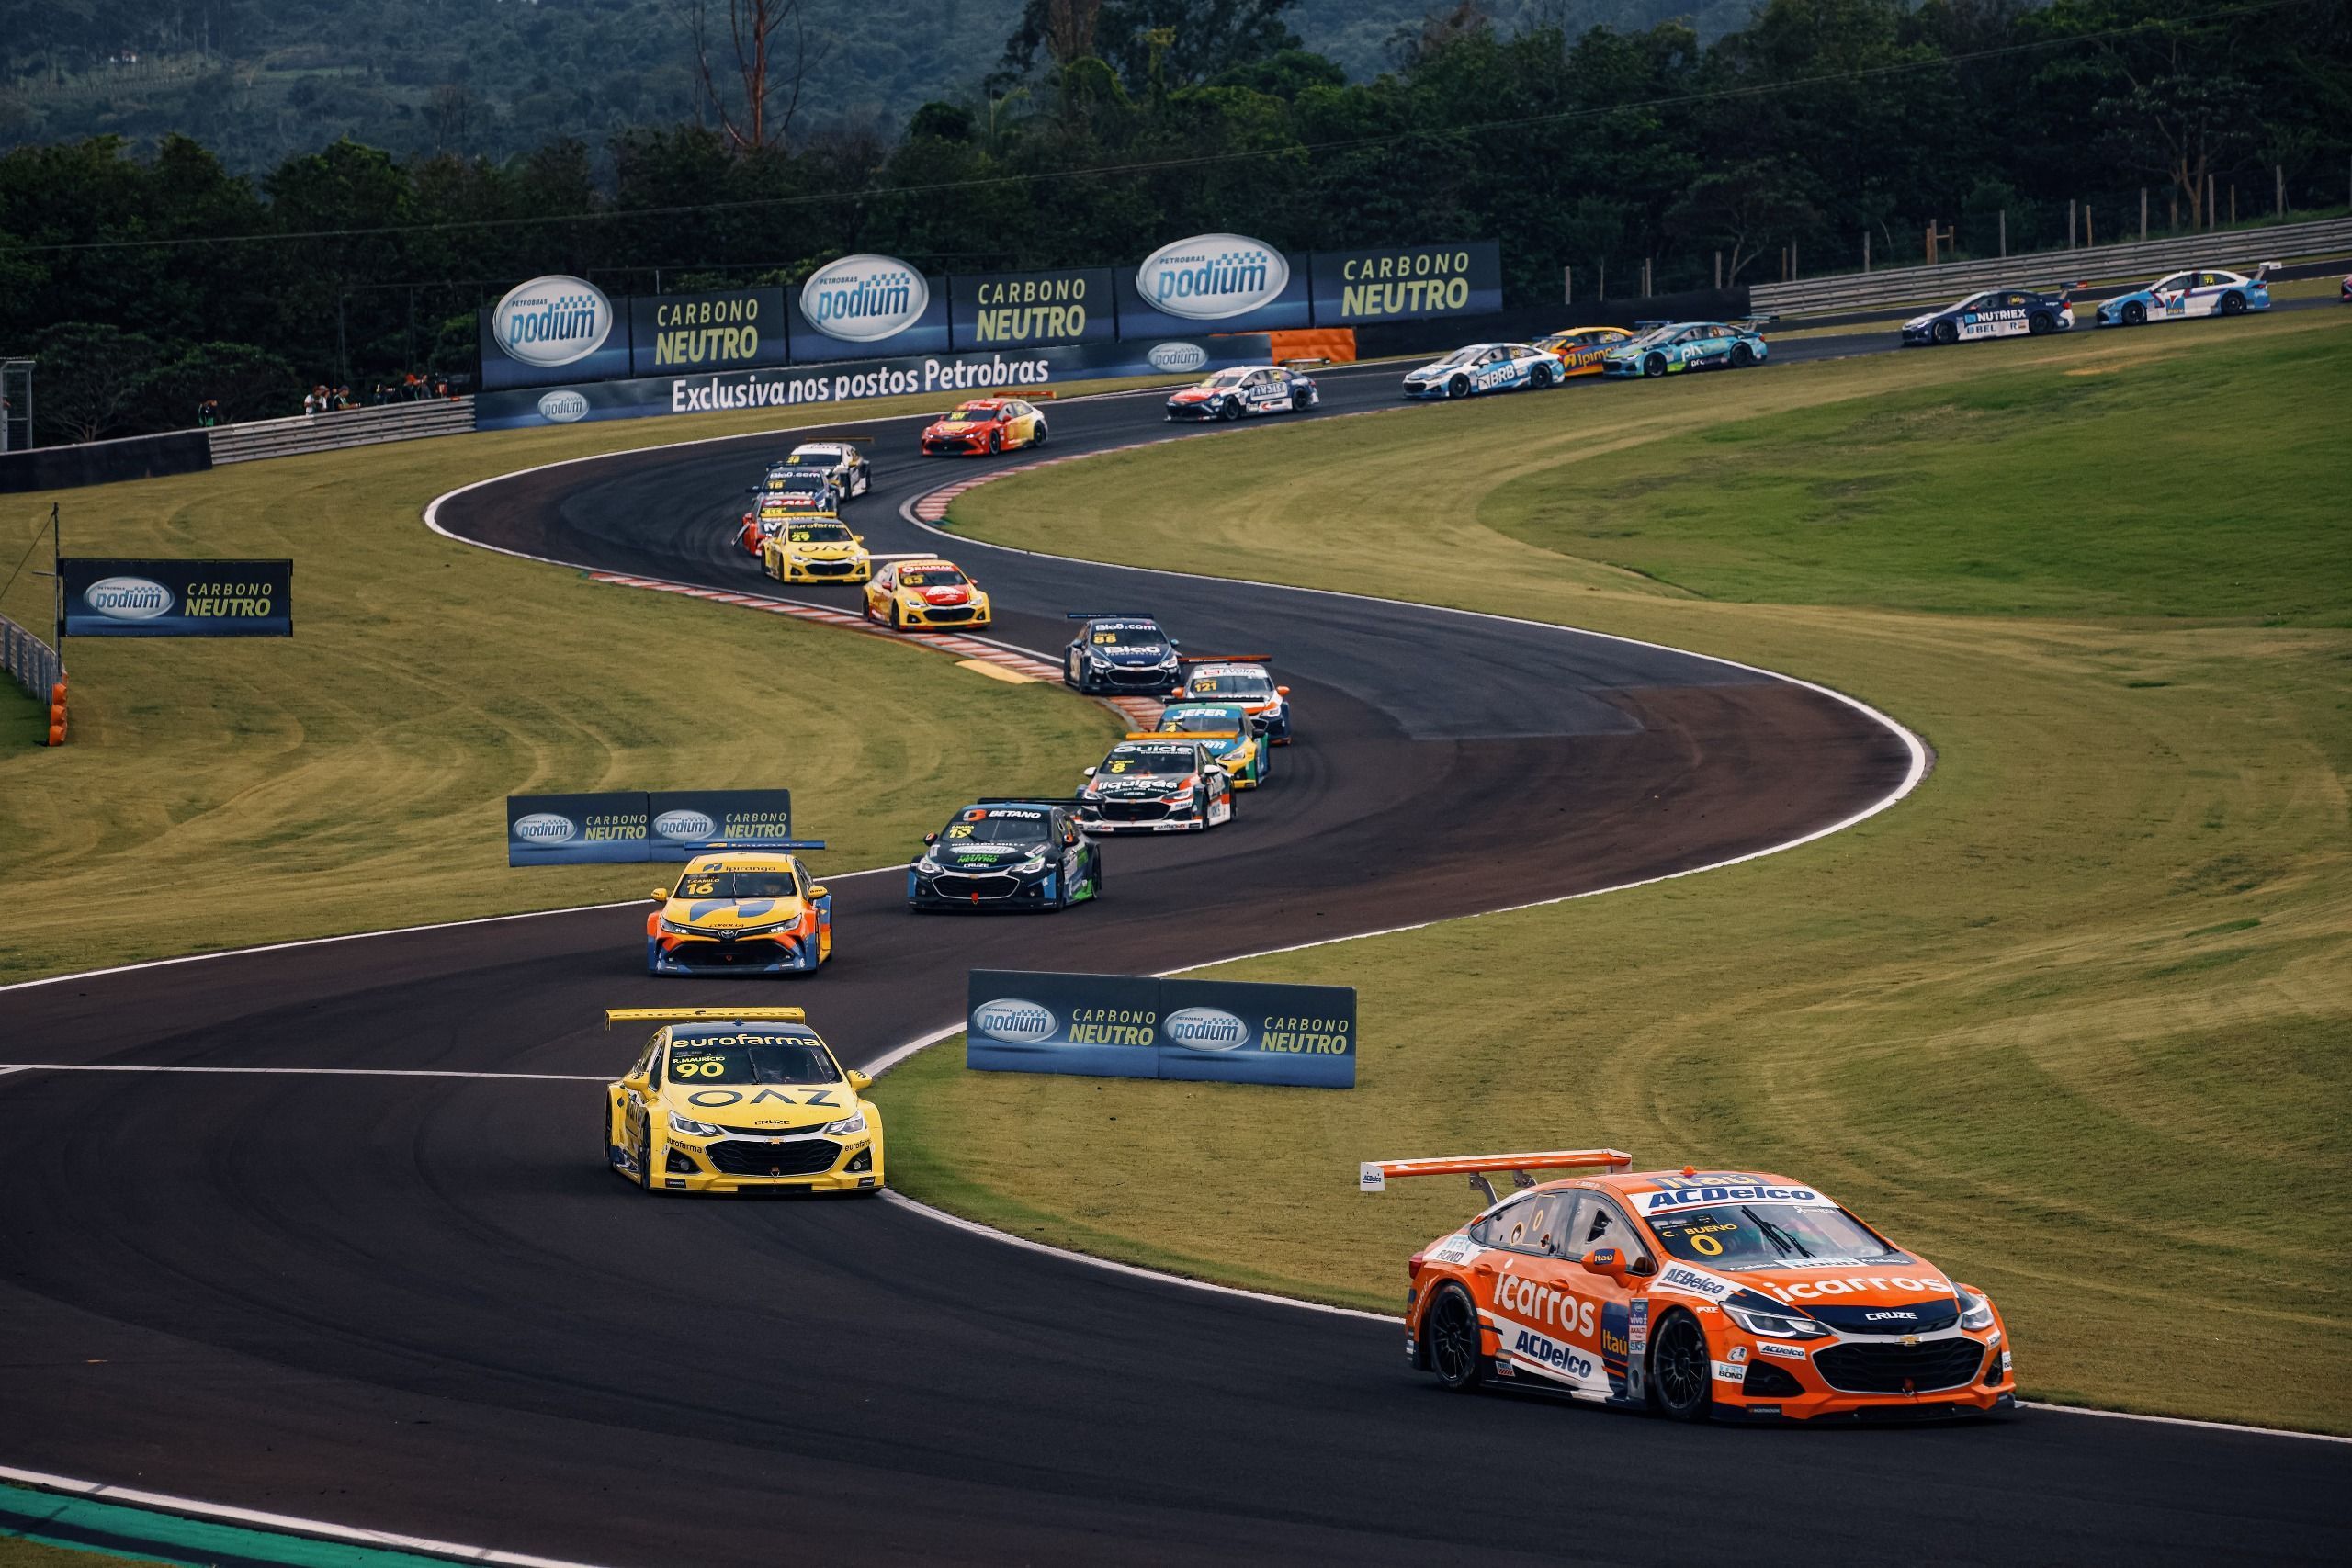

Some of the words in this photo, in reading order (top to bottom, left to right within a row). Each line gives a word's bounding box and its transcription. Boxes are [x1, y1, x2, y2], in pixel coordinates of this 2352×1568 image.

[1159, 254, 1206, 265] PETROBRAS
[1343, 251, 1470, 281] CARBONO
[820, 276, 858, 285] PETROBRAS
[1156, 258, 1269, 303] podium
[978, 278, 1086, 305] CARBONO
[1341, 276, 1470, 318] NEUTRO
[511, 298, 548, 307] PETROBRAS
[815, 279, 910, 325] podium
[657, 298, 759, 327] CARBONO
[1976, 309, 2027, 322] NUTRIEX
[509, 303, 596, 348] podium
[976, 304, 1086, 342] NEUTRO
[655, 324, 759, 366] NEUTRO
[1154, 351, 1200, 366] podium
[672, 375, 786, 413] Exclusiva
[788, 378, 829, 404] nos
[835, 367, 919, 401] postos
[924, 354, 1049, 391] Petrobras
[1489, 365, 1516, 387] BRB
[544, 397, 582, 415] podium
[791, 533, 811, 542] 29
[187, 582, 273, 596] CARBONO
[95, 588, 162, 611] podium
[184, 597, 272, 617] NEUTRO
[1093, 635, 1117, 645] 88
[1194, 681, 1217, 693] 121
[1172, 708, 1227, 720] JEFER
[1110, 762, 1126, 773] 8
[585, 814, 648, 826] CARBONO
[725, 812, 787, 823] CARBONO
[989, 810, 1042, 818] BETANO
[520, 819, 568, 840] podium
[584, 823, 647, 840] NEUTRO
[660, 818, 707, 835] podium
[723, 822, 787, 840] NEUTRO
[957, 855, 998, 863] NEUTRO
[725, 864, 776, 873] ipiranga
[686, 883, 715, 895] 16
[983, 1010, 1046, 1033] podium
[1072, 1008, 1156, 1026] CARBONO
[1264, 1016, 1349, 1032] CARBONO
[1069, 1023, 1154, 1046] NEUTRO
[1173, 1018, 1238, 1042] podium
[672, 1033, 821, 1048] eurofarma
[1261, 1032, 1348, 1055] NEUTRO
[675, 1061, 725, 1078] 90
[666, 1135, 703, 1154] eurofarma
[1363, 1175, 1382, 1183] ACDelco
[1657, 1174, 1760, 1190] Itaú
[1647, 1186, 1815, 1209] ACDelco
[1684, 1223, 1738, 1235] BUENO
[1690, 1235, 1724, 1257] 0
[1436, 1249, 1464, 1263] BOND
[1594, 1251, 1614, 1263] Itaú
[1661, 1268, 1725, 1294] ACDelco
[1493, 1258, 1596, 1338] icarros
[1762, 1277, 1953, 1303] icarros
[1864, 1311, 1919, 1321] CRUZE
[1602, 1329, 1628, 1356] Itaú
[1630, 1341, 1646, 1351] SKF
[1761, 1345, 1804, 1357] ACDelco
[1515, 1329, 1592, 1379] ACDelco
[1719, 1370, 1743, 1380] BOND
